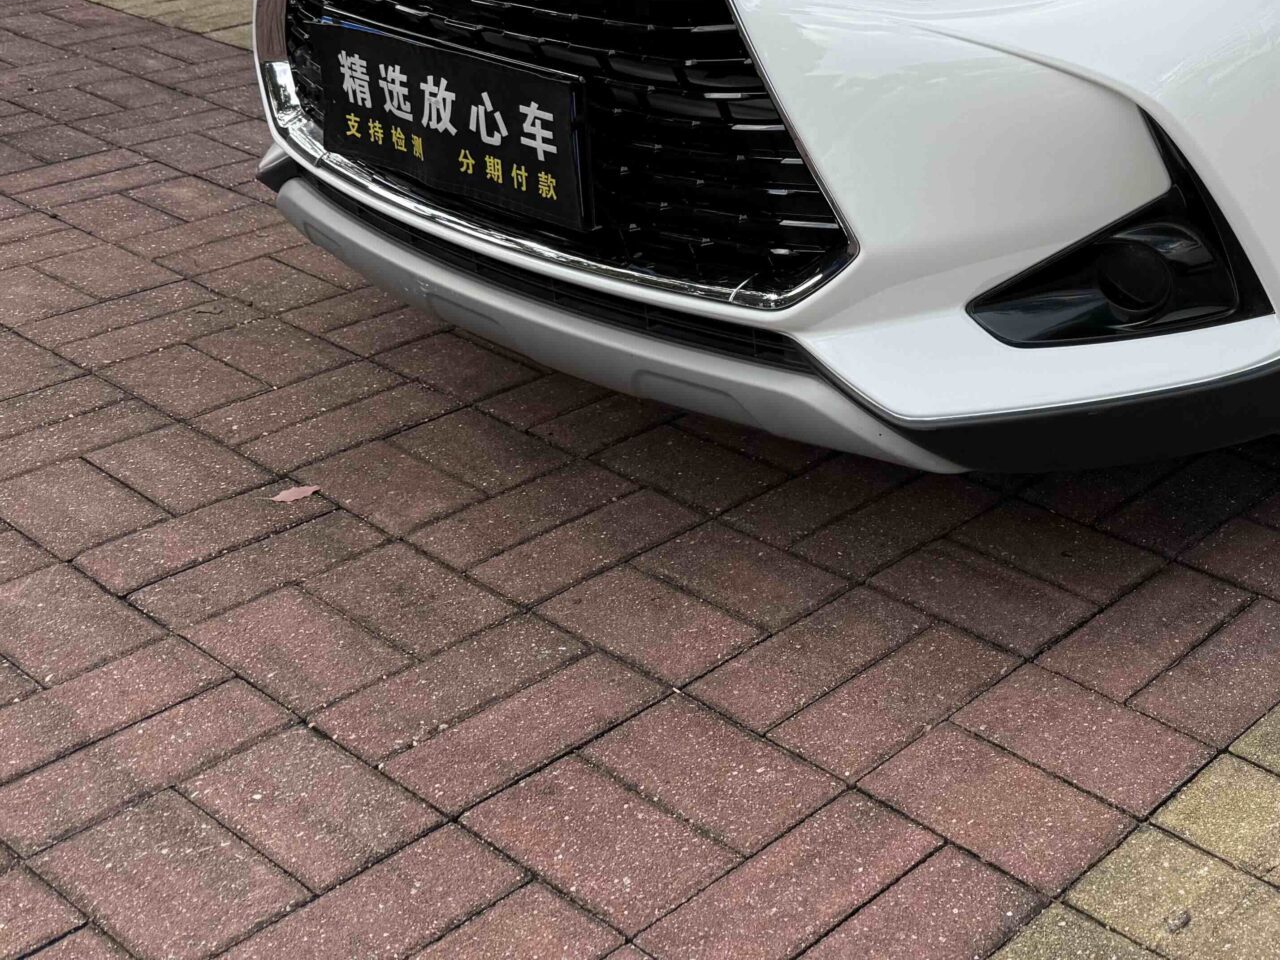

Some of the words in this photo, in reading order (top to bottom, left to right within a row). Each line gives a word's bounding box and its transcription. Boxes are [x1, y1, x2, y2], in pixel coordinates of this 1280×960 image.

[338, 50, 557, 161] 精选放心车
[345, 113, 424, 161] 支持检测
[458, 149, 557, 200] 分期付款
